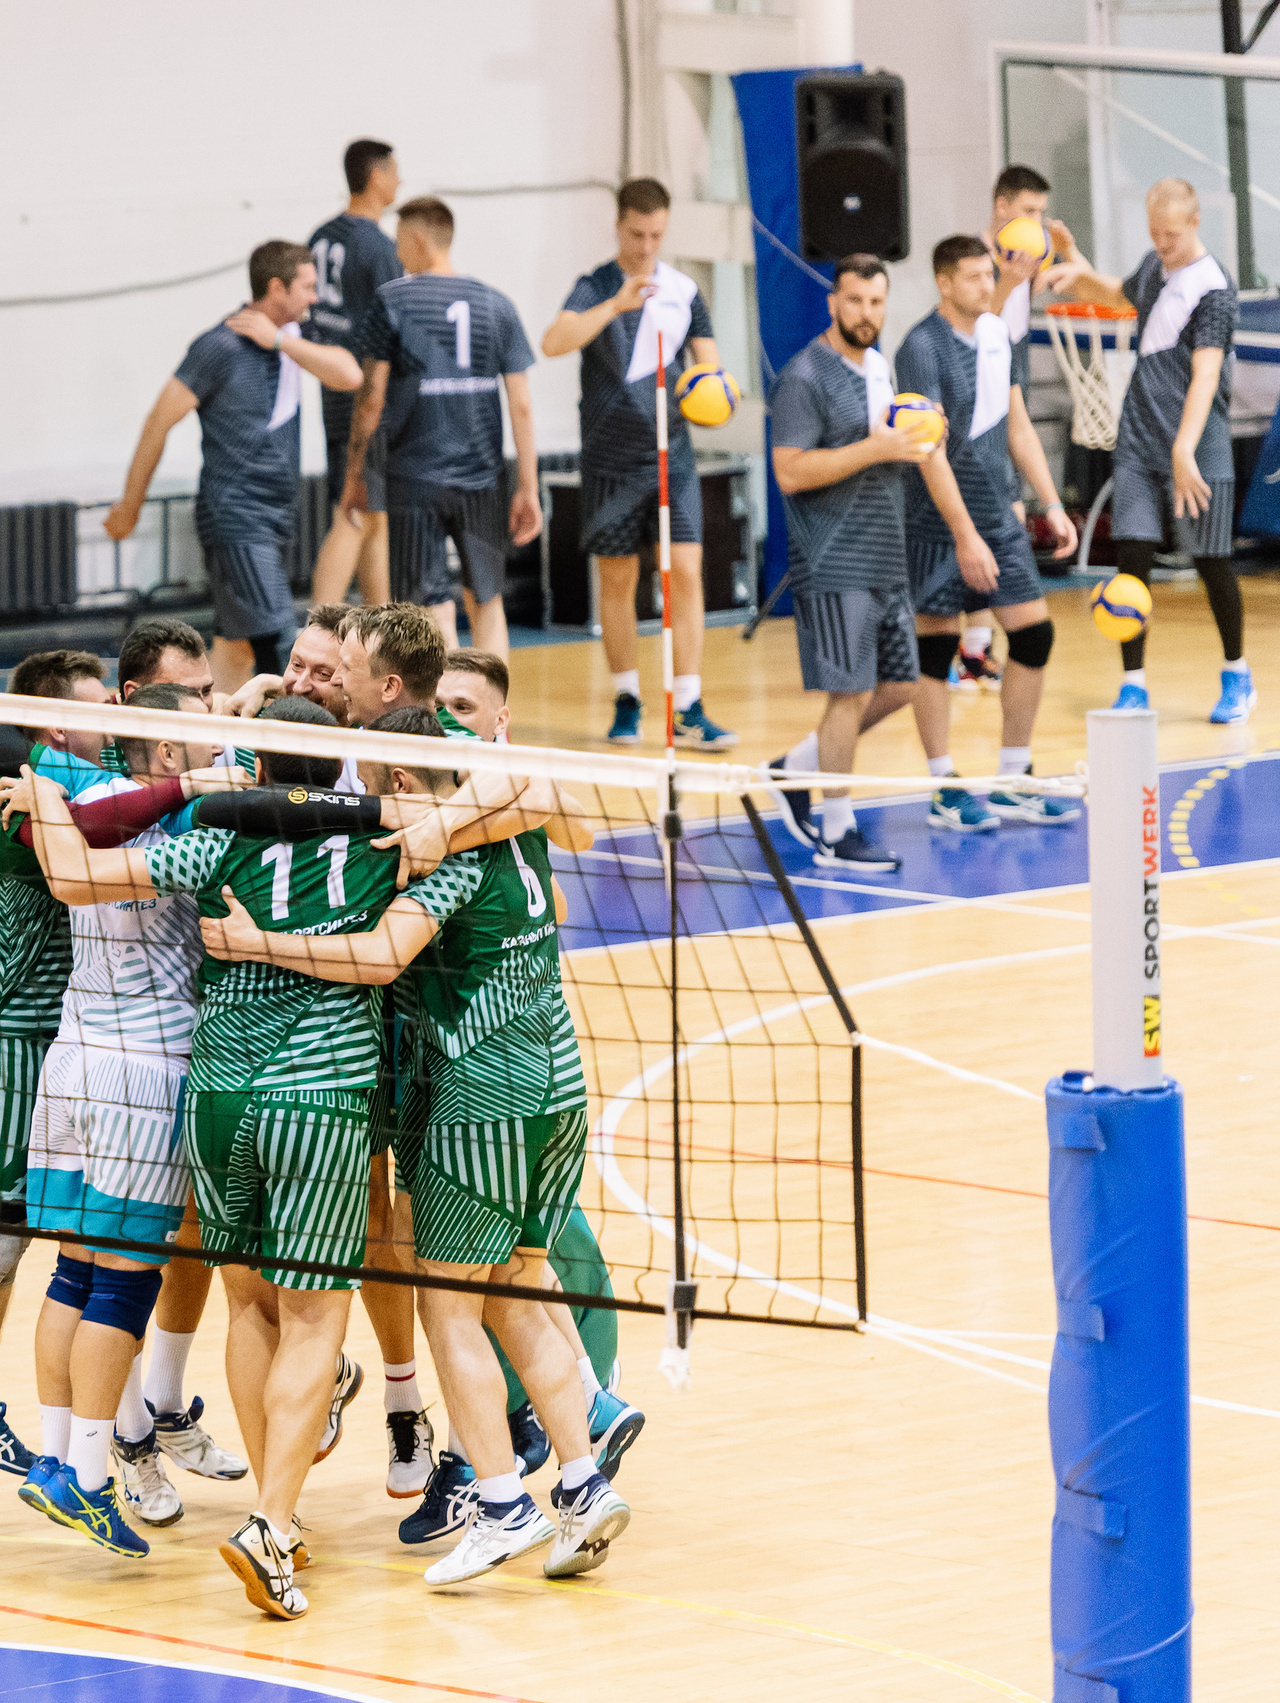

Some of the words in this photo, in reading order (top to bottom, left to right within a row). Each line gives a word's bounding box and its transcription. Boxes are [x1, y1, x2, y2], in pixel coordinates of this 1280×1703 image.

[446, 300, 470, 369] 1
[261, 834, 350, 921] 11
[1142, 784, 1160, 979] SPORTWERK
